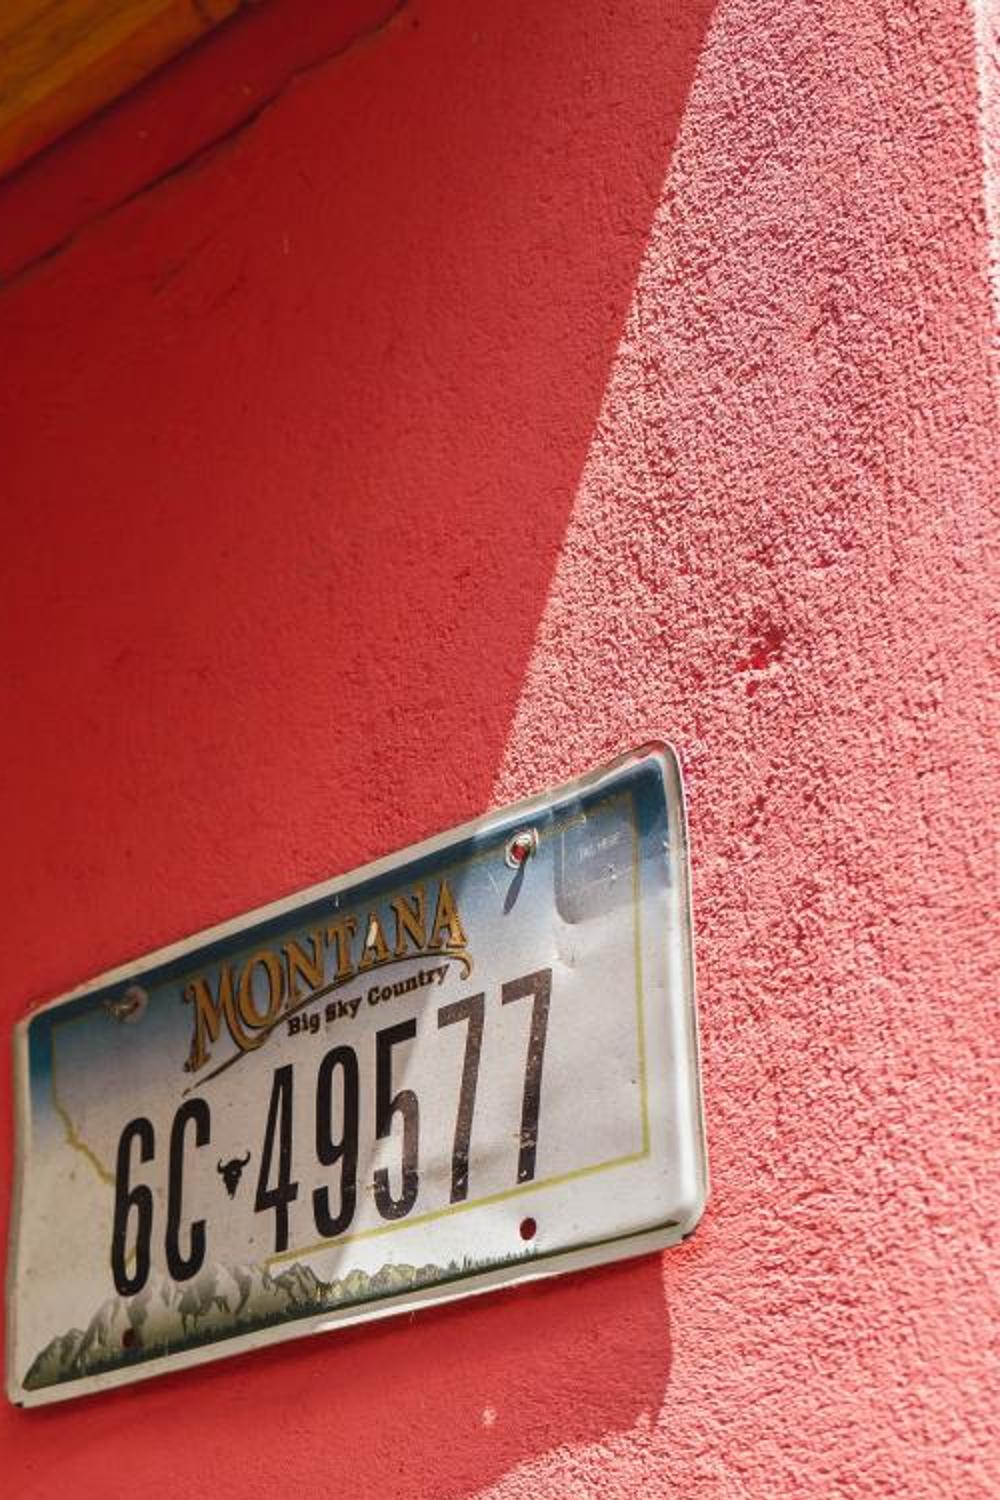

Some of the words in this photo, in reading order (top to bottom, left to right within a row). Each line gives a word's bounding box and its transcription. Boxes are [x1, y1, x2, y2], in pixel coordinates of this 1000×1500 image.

[183, 878, 468, 1074] MONTANA
[288, 1012, 321, 1037] Big
[325, 997, 363, 1023] Sky
[367, 963, 450, 1006] Country
